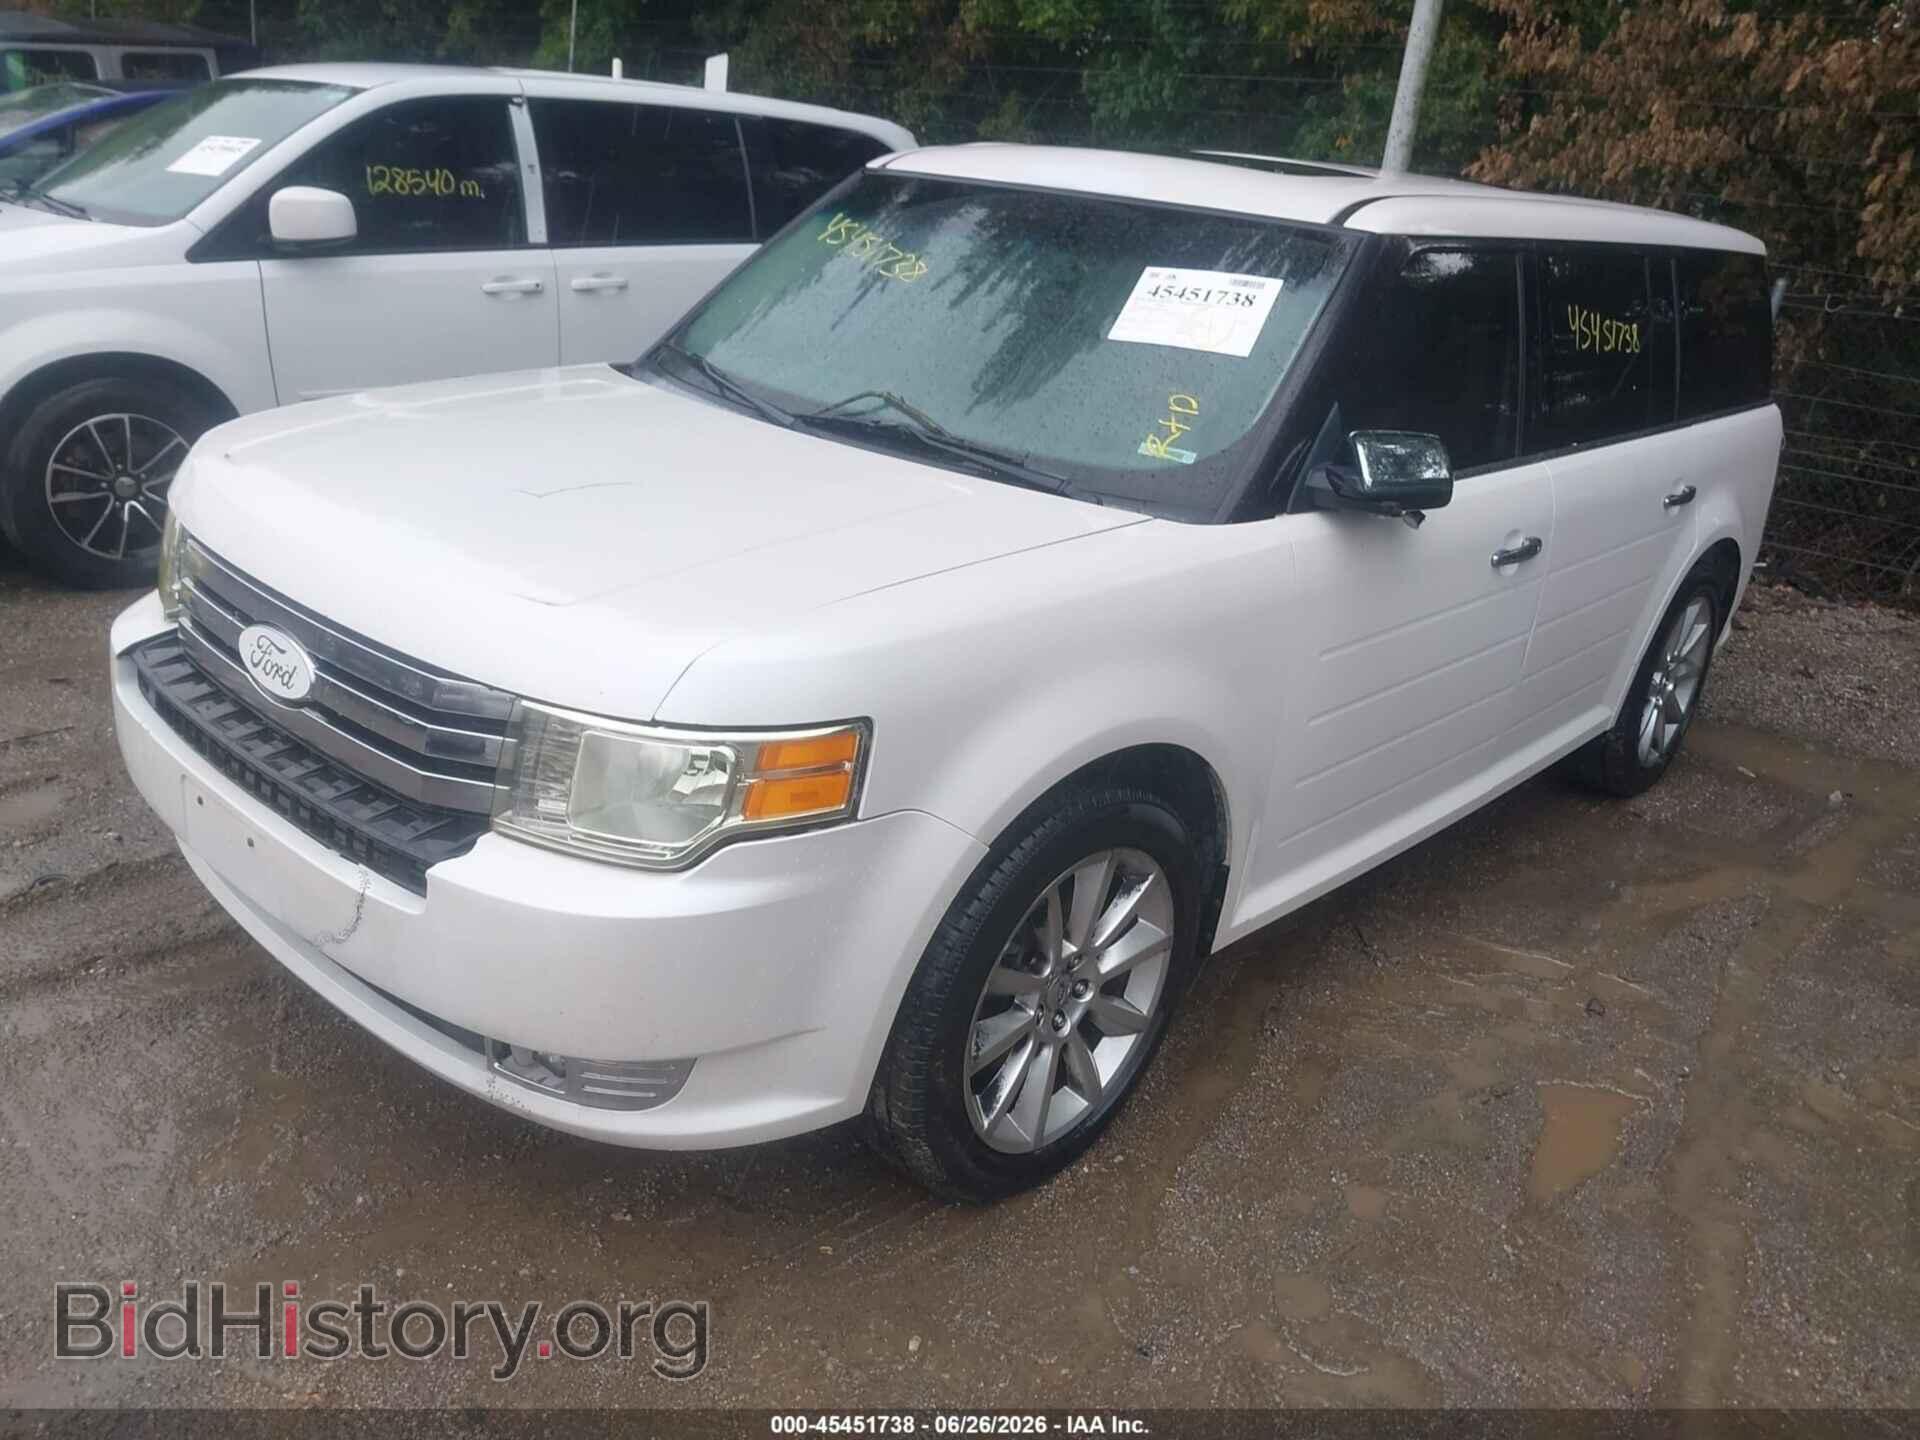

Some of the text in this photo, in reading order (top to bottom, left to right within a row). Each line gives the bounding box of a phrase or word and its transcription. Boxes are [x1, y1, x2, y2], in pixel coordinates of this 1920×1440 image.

[366, 165, 456, 196] 128540
[1147, 284, 1257, 308] 45451738
[1567, 304, 1641, 355] 45451738
[250, 634, 297, 690] Ford
